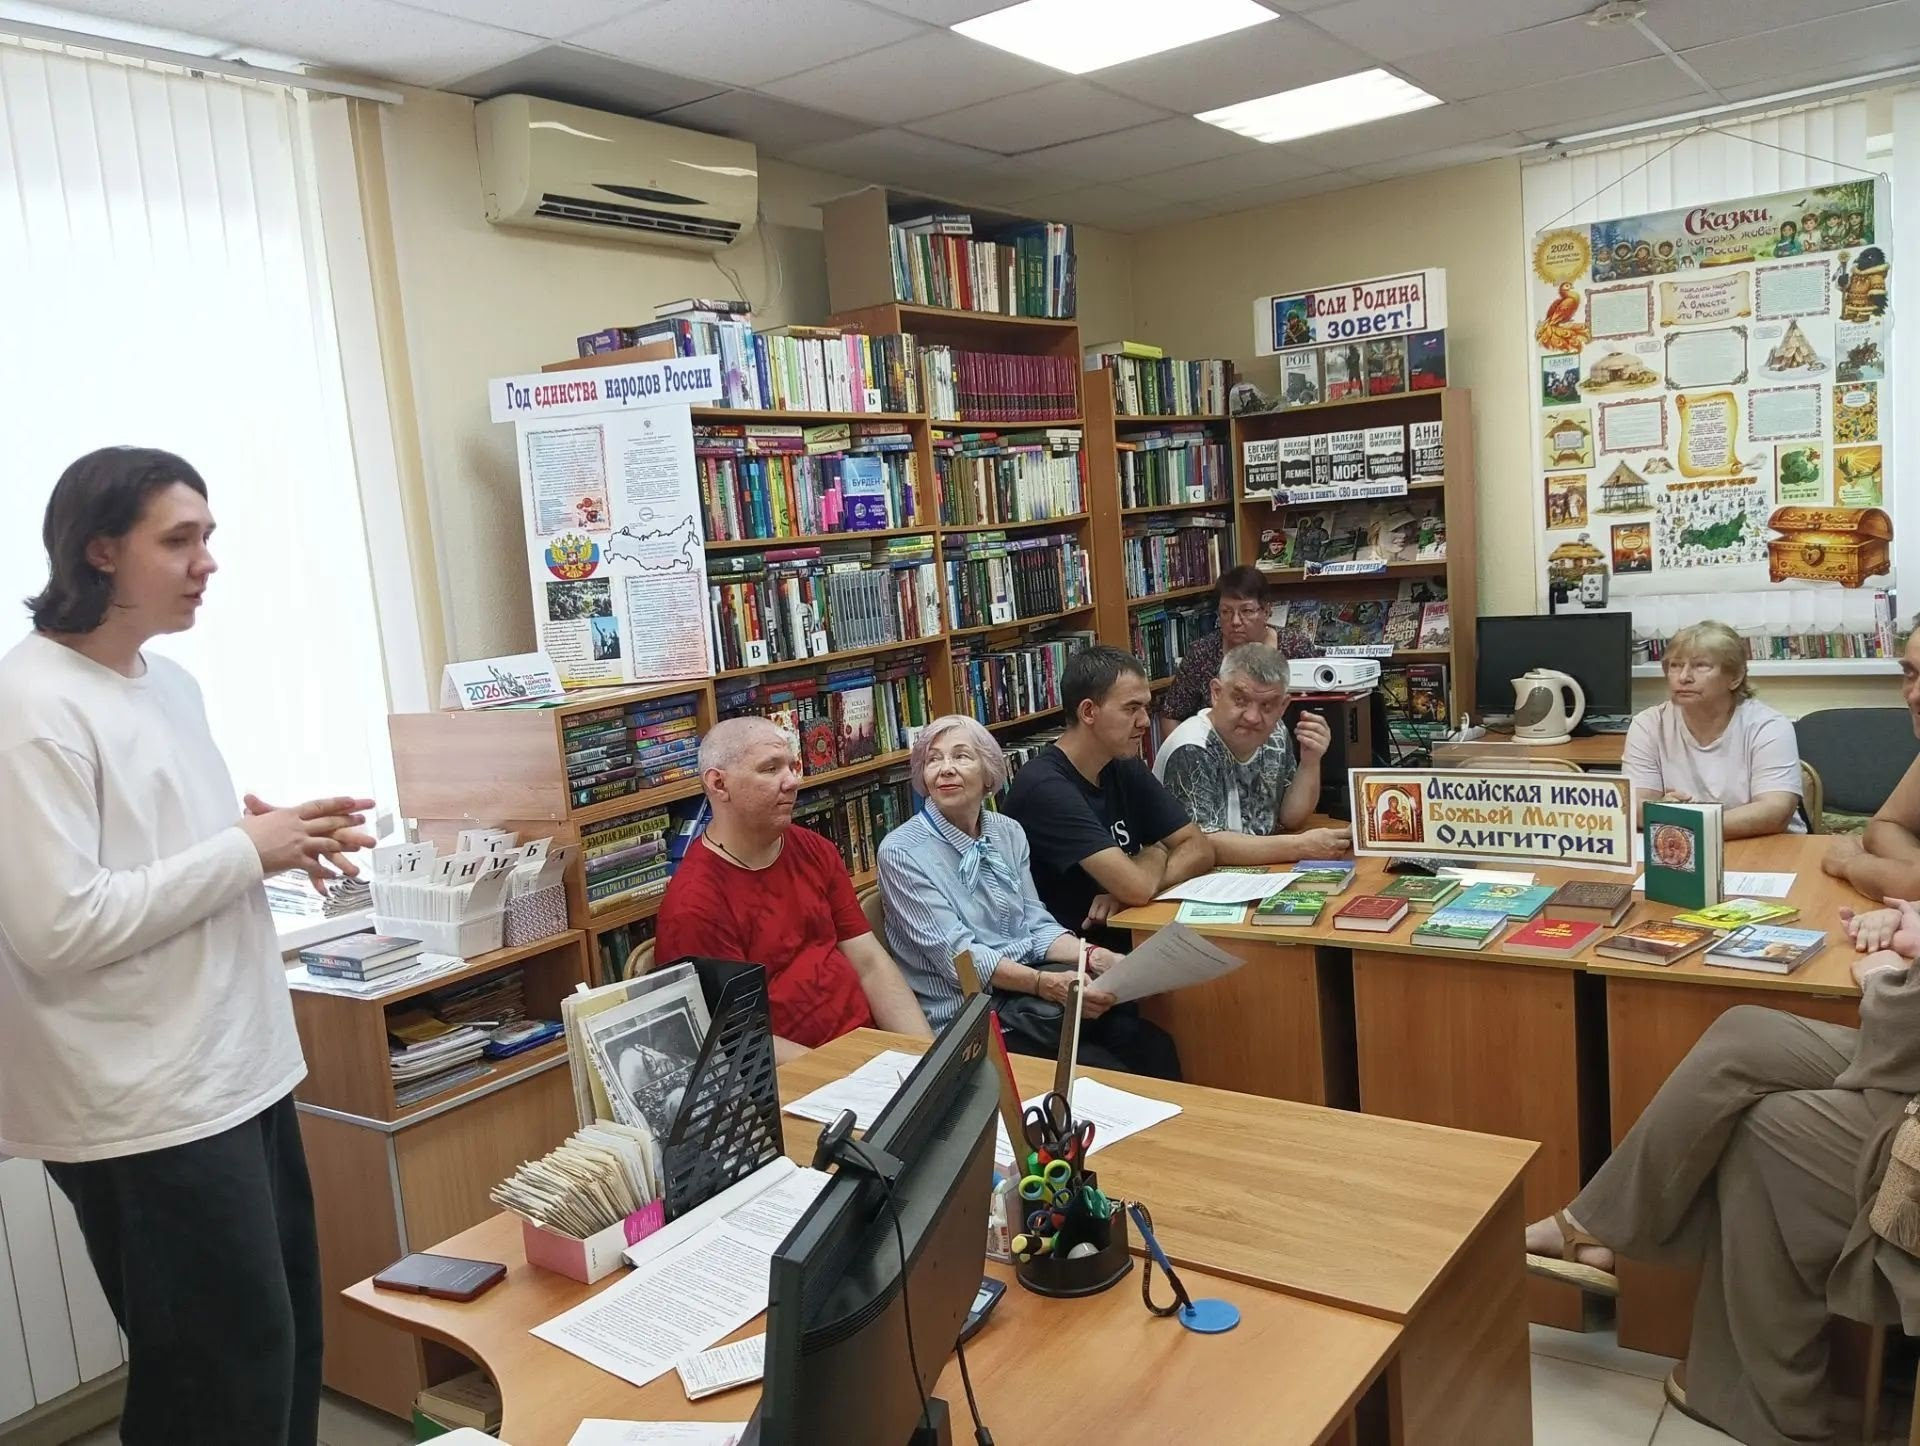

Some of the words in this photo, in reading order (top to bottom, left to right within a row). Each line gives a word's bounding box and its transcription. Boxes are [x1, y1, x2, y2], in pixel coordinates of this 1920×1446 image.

[1551, 242, 1574, 253] 2026
[1305, 294, 1347, 319] Если
[1352, 283, 1421, 312] Родина
[1327, 303, 1412, 340] зовет!
[506, 382, 531, 410] Год
[534, 380, 598, 408] единства
[605, 373, 660, 405] народов
[664, 365, 713, 393] России
[1331, 433, 1363, 443] ВАЛЕРИЯ
[1415, 424, 1443, 439] АНН
[1314, 437, 1327, 448] ИР
[1422, 448, 1444, 460] ЗДЕС
[1285, 469, 1311, 480] ЛЕМНЕ
[1332, 464, 1364, 480] МОРЕ
[1193, 489, 1201, 499] С
[1338, 487, 1351, 498] СВО
[1352, 489, 1359, 497] на
[752, 645, 760, 659] В
[466, 683, 501, 701] 2026
[1427, 777, 1541, 804] Аксайская
[1551, 785, 1619, 808] икона
[1429, 802, 1513, 825] Божьей
[1521, 806, 1613, 836] Матери
[526, 843, 541, 857] Б
[408, 857, 420, 872] Т
[460, 862, 476, 877] Н
[488, 857, 509, 870] М
